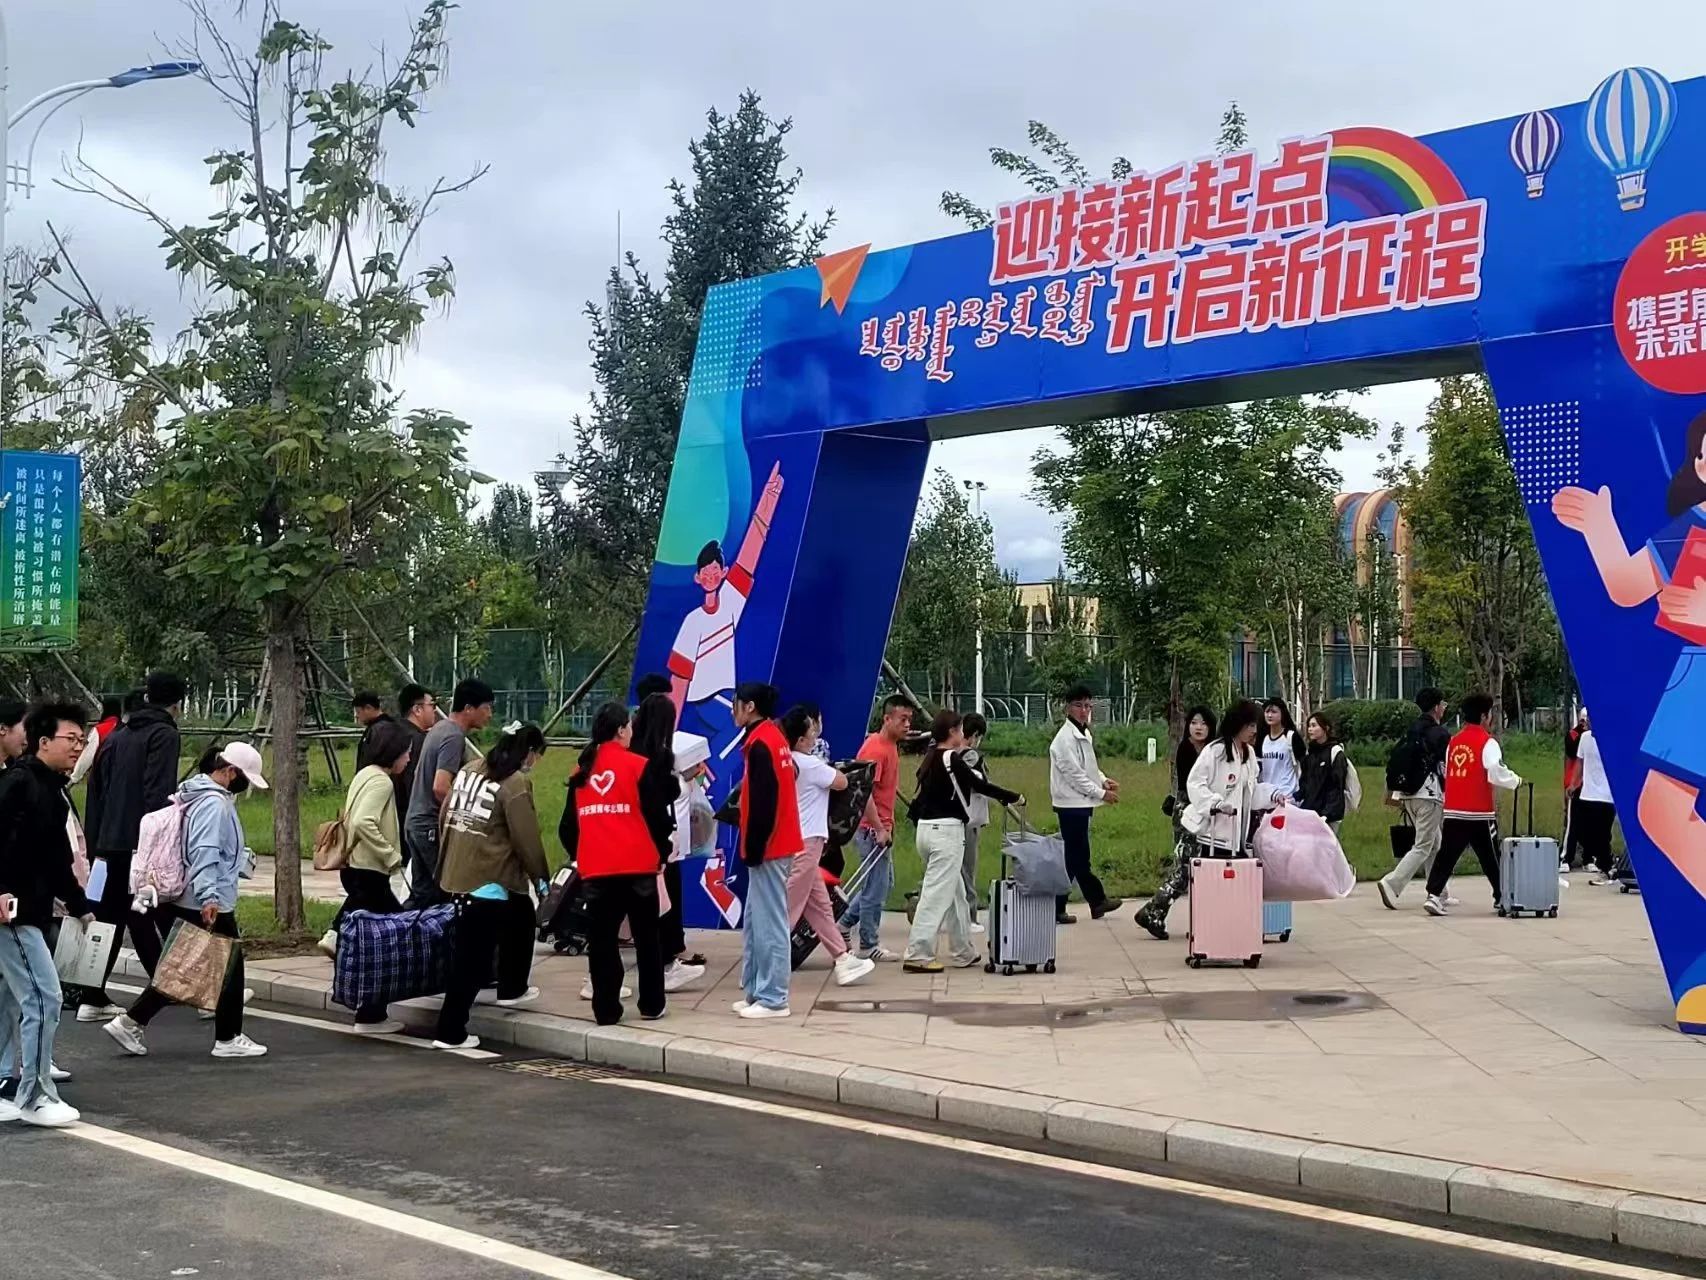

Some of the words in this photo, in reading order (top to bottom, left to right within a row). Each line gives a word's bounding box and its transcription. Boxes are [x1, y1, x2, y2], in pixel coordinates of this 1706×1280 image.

[990, 134, 1331, 286] 迎接新起点
[1106, 199, 1487, 353] 开启新征程
[1635, 320, 1706, 361] 未来
[31, 468, 46, 626] 只是很容易被习惯所掩盖
[49, 467, 63, 626] 每个人都有潜在的能量
